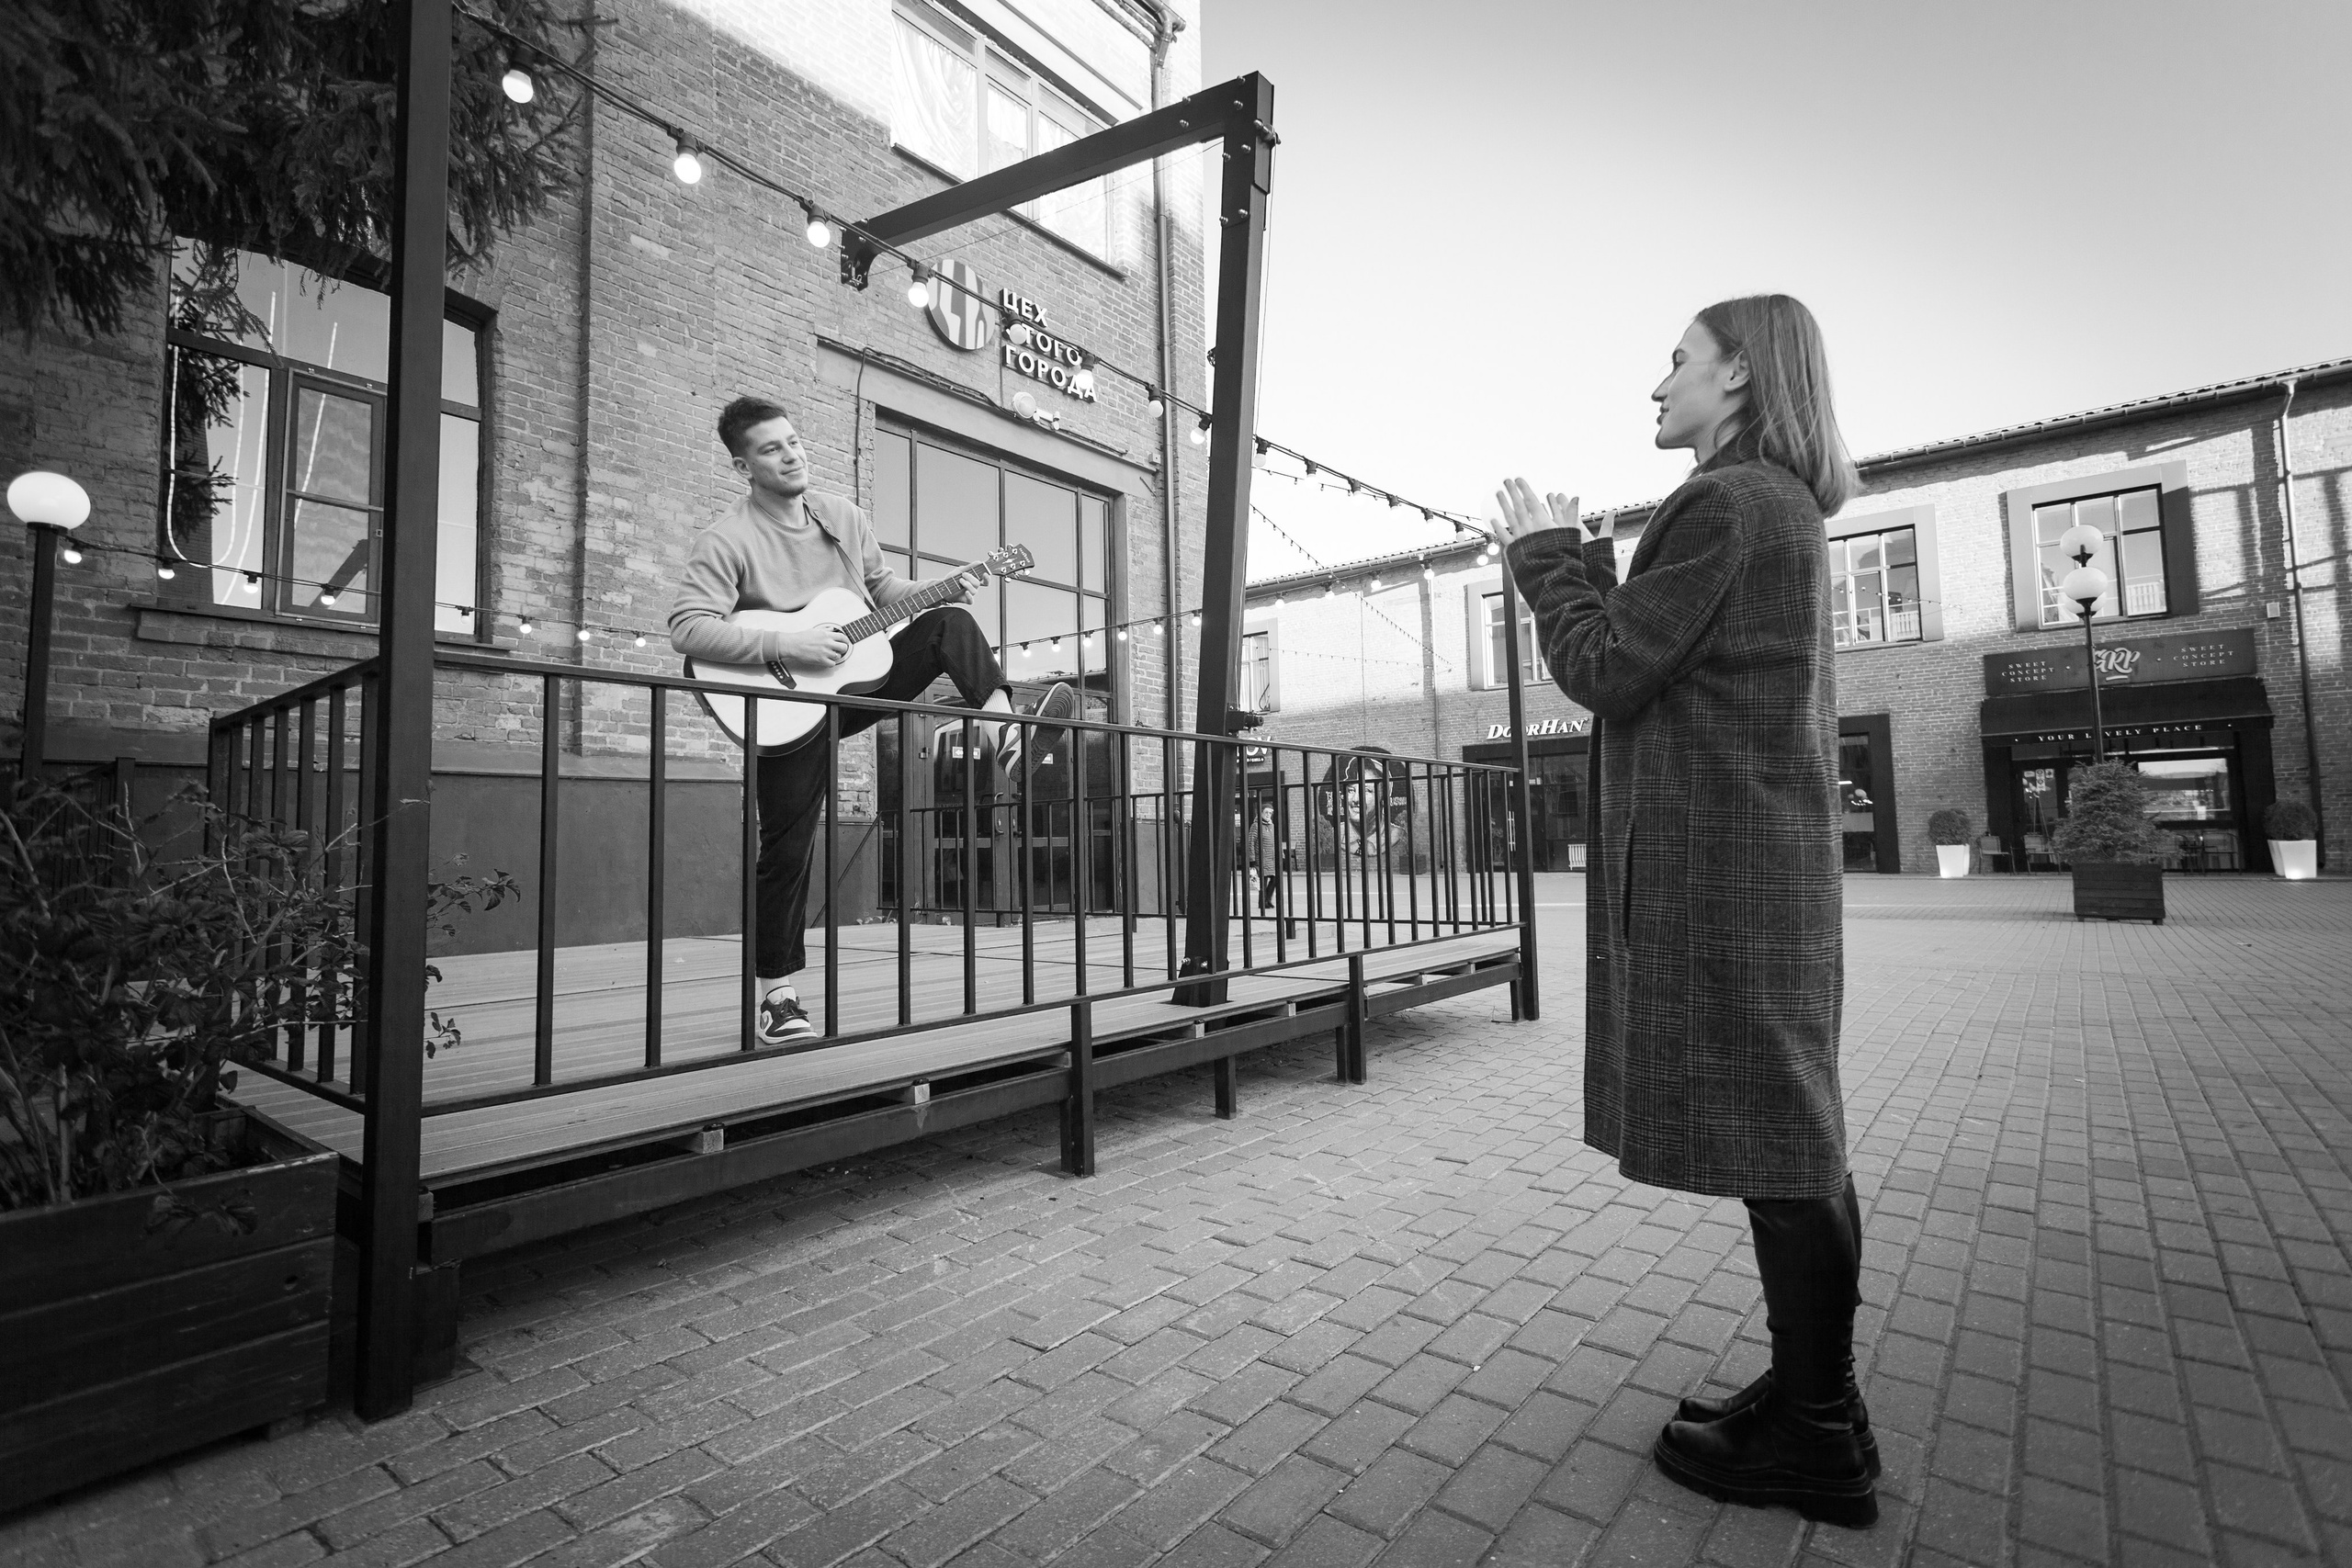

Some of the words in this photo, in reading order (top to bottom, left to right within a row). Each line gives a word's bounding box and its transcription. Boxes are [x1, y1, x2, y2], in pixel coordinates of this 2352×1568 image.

[1002, 288, 1047, 327] ЦЕХ
[1005, 323, 1082, 366] ТОГО
[2180, 644, 2223, 652] SWEET
[2173, 650, 2233, 660] CONCEPT
[2183, 660, 2225, 668] STORE
[2001, 668, 2054, 677] CONCEPT
[2086, 728, 2142, 739] LVELY
[2153, 725, 2202, 733] PLACE
